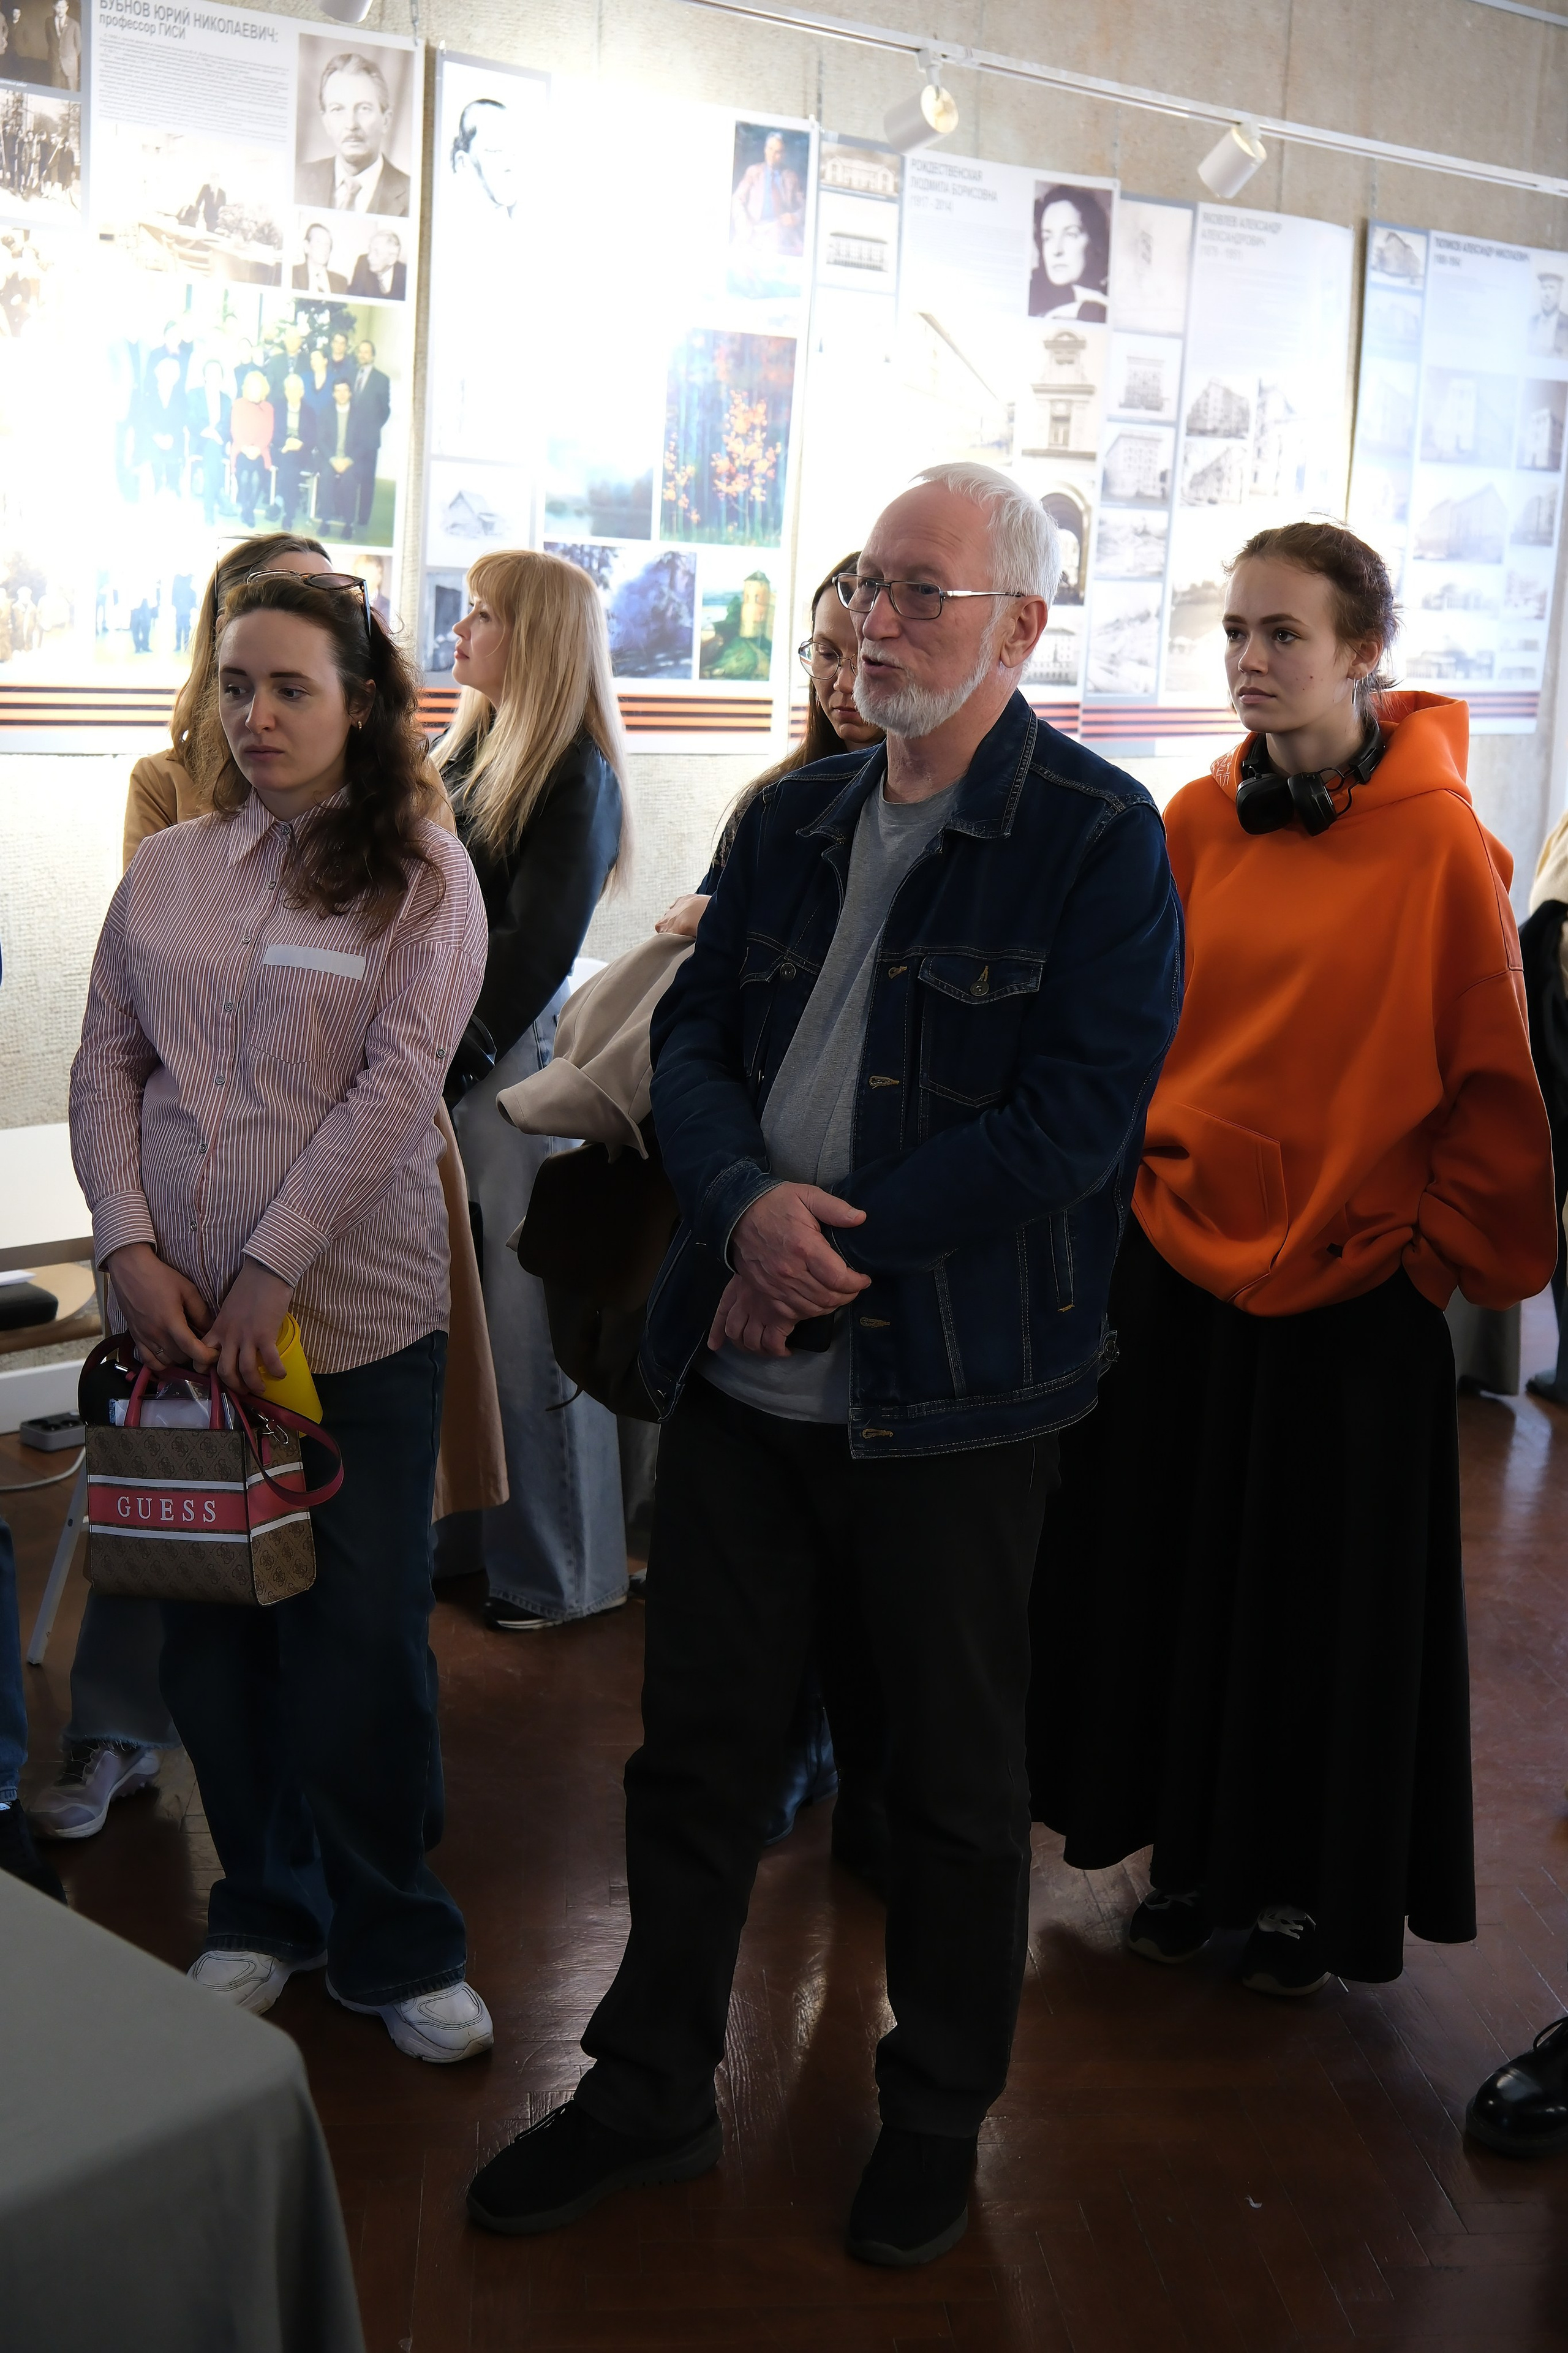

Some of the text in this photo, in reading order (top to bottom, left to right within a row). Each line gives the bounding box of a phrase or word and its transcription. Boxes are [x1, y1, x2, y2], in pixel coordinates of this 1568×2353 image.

[99, 14, 186, 39] профессор ГИСИ
[100, 0, 279, 43] БУБНОВ ЮРИЙ НИКОЛАЕВИЧ:
[117, 1496, 216, 1522] GUESS
